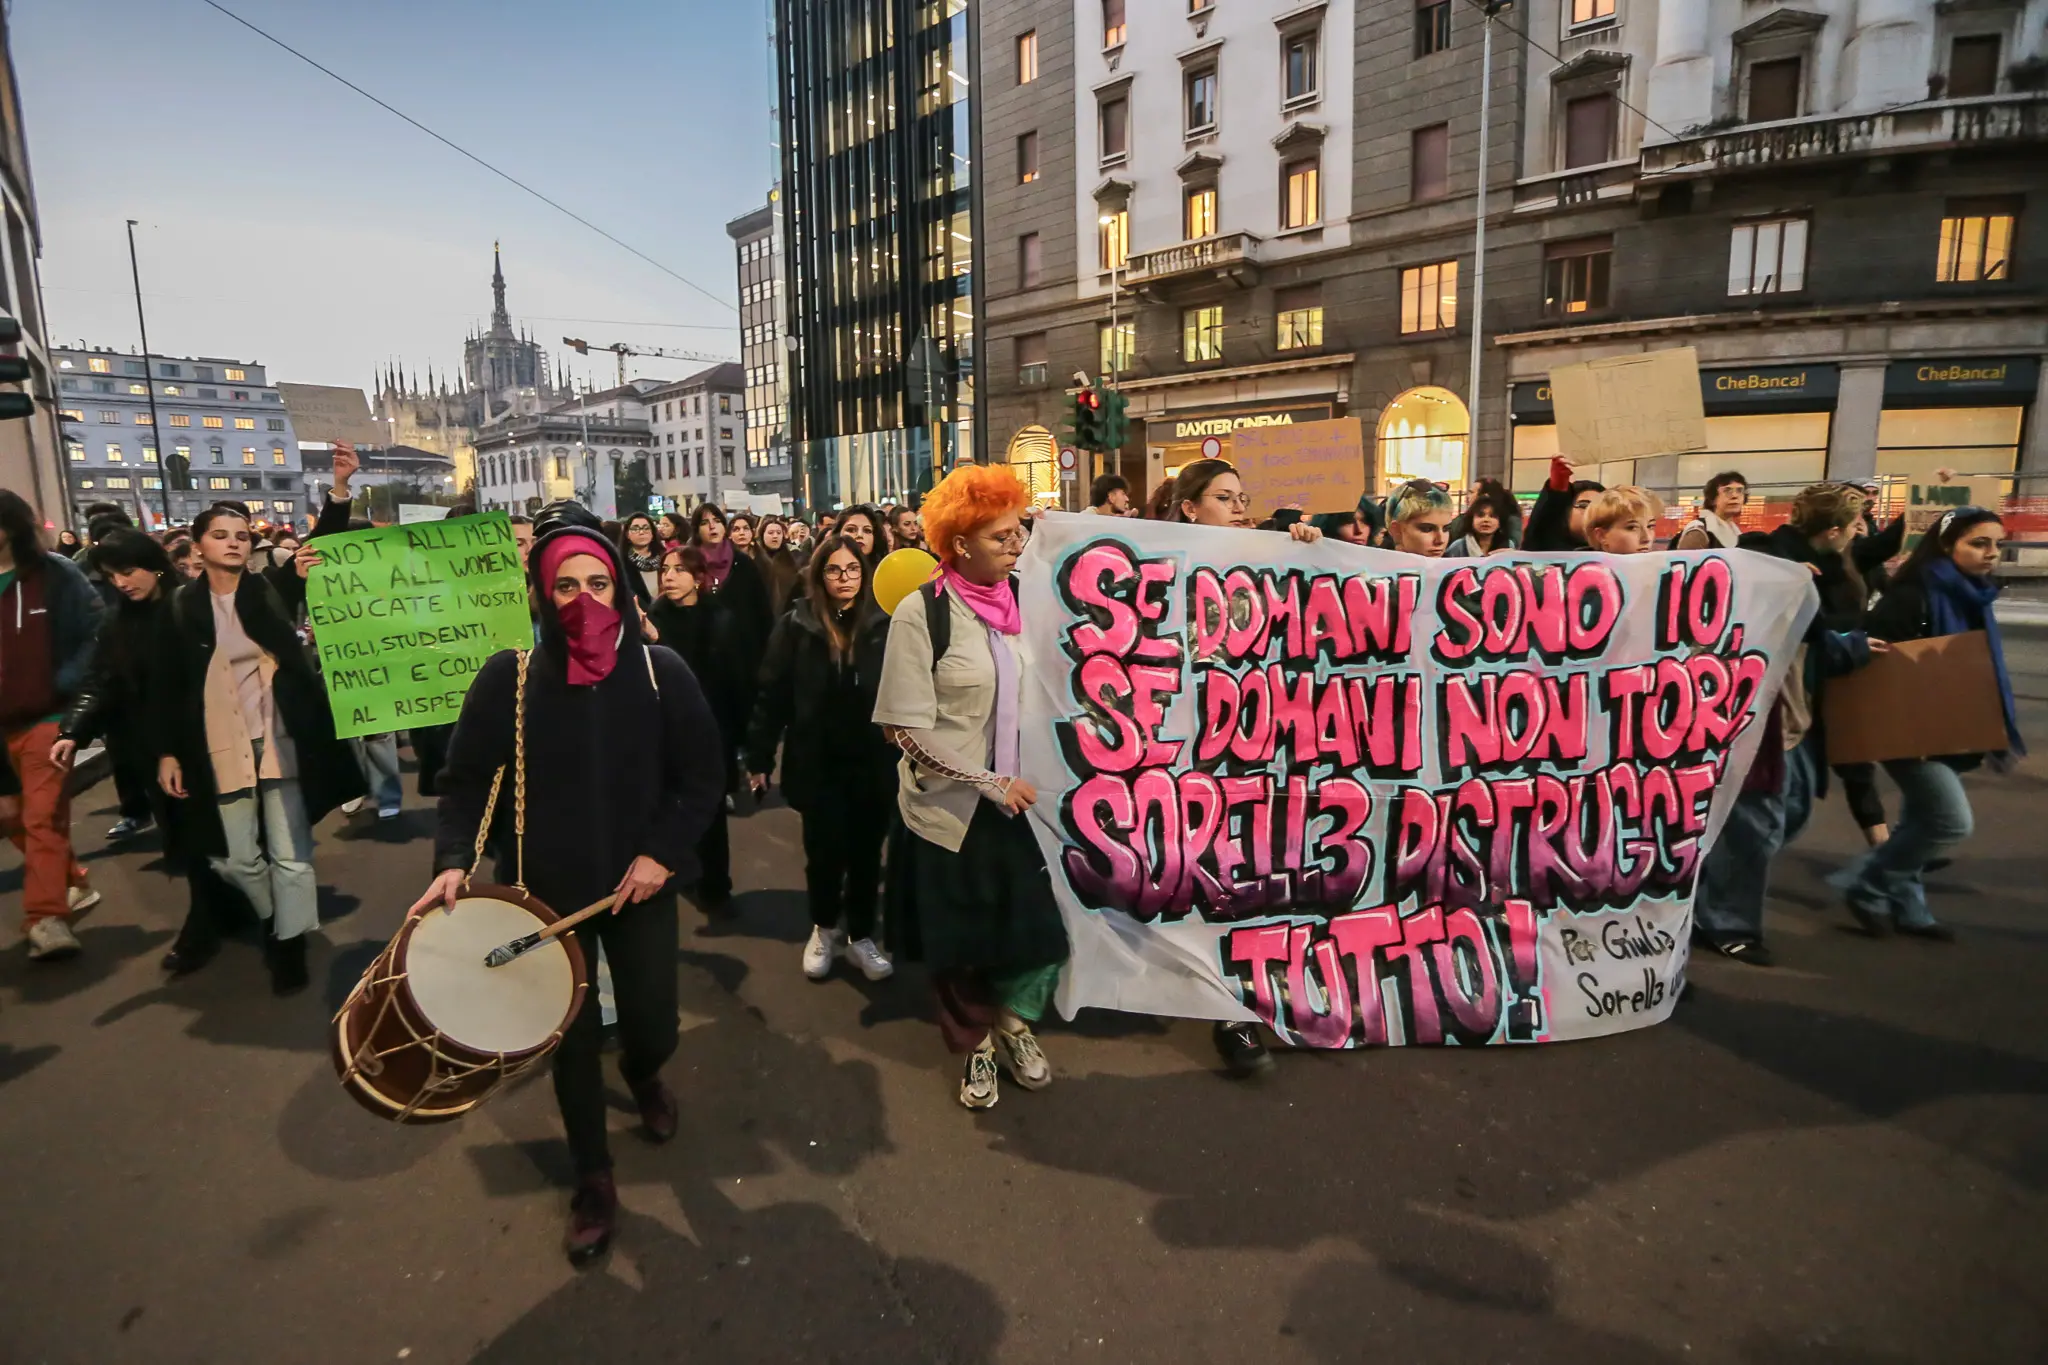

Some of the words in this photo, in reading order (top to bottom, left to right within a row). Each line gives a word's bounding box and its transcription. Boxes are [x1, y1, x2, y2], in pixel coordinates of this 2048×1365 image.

[1716, 372, 1806, 390] CheBanca!
[1917, 364, 2006, 381] CheBanca!
[1176, 419, 1232, 437] BAXTER
[1233, 413, 1293, 429] CINEMA
[317, 536, 383, 567] NOT
[406, 528, 456, 551] ALL
[464, 519, 513, 547] MEN
[322, 571, 369, 597] MA
[390, 561, 444, 589] ALL
[449, 551, 519, 578] WOMEN
[311, 594, 444, 626] EDUCATE
[468, 590, 523, 607] VOSTRI
[1060, 539, 1185, 661] SE
[1189, 566, 1421, 664] DOMANI
[1432, 559, 1624, 666] SONO
[332, 665, 390, 692] AMICI
[411, 663, 429, 681] E
[439, 656, 481, 677] COLL
[352, 706, 377, 726] AL
[1072, 653, 1184, 773] SE
[1197, 663, 1424, 771] DOMANI
[1441, 670, 1589, 770] NON
[1394, 762, 1716, 908] DISTRUGGE
[1560, 928, 1597, 965] Per
[1226, 898, 1538, 1047] TUTTO!
